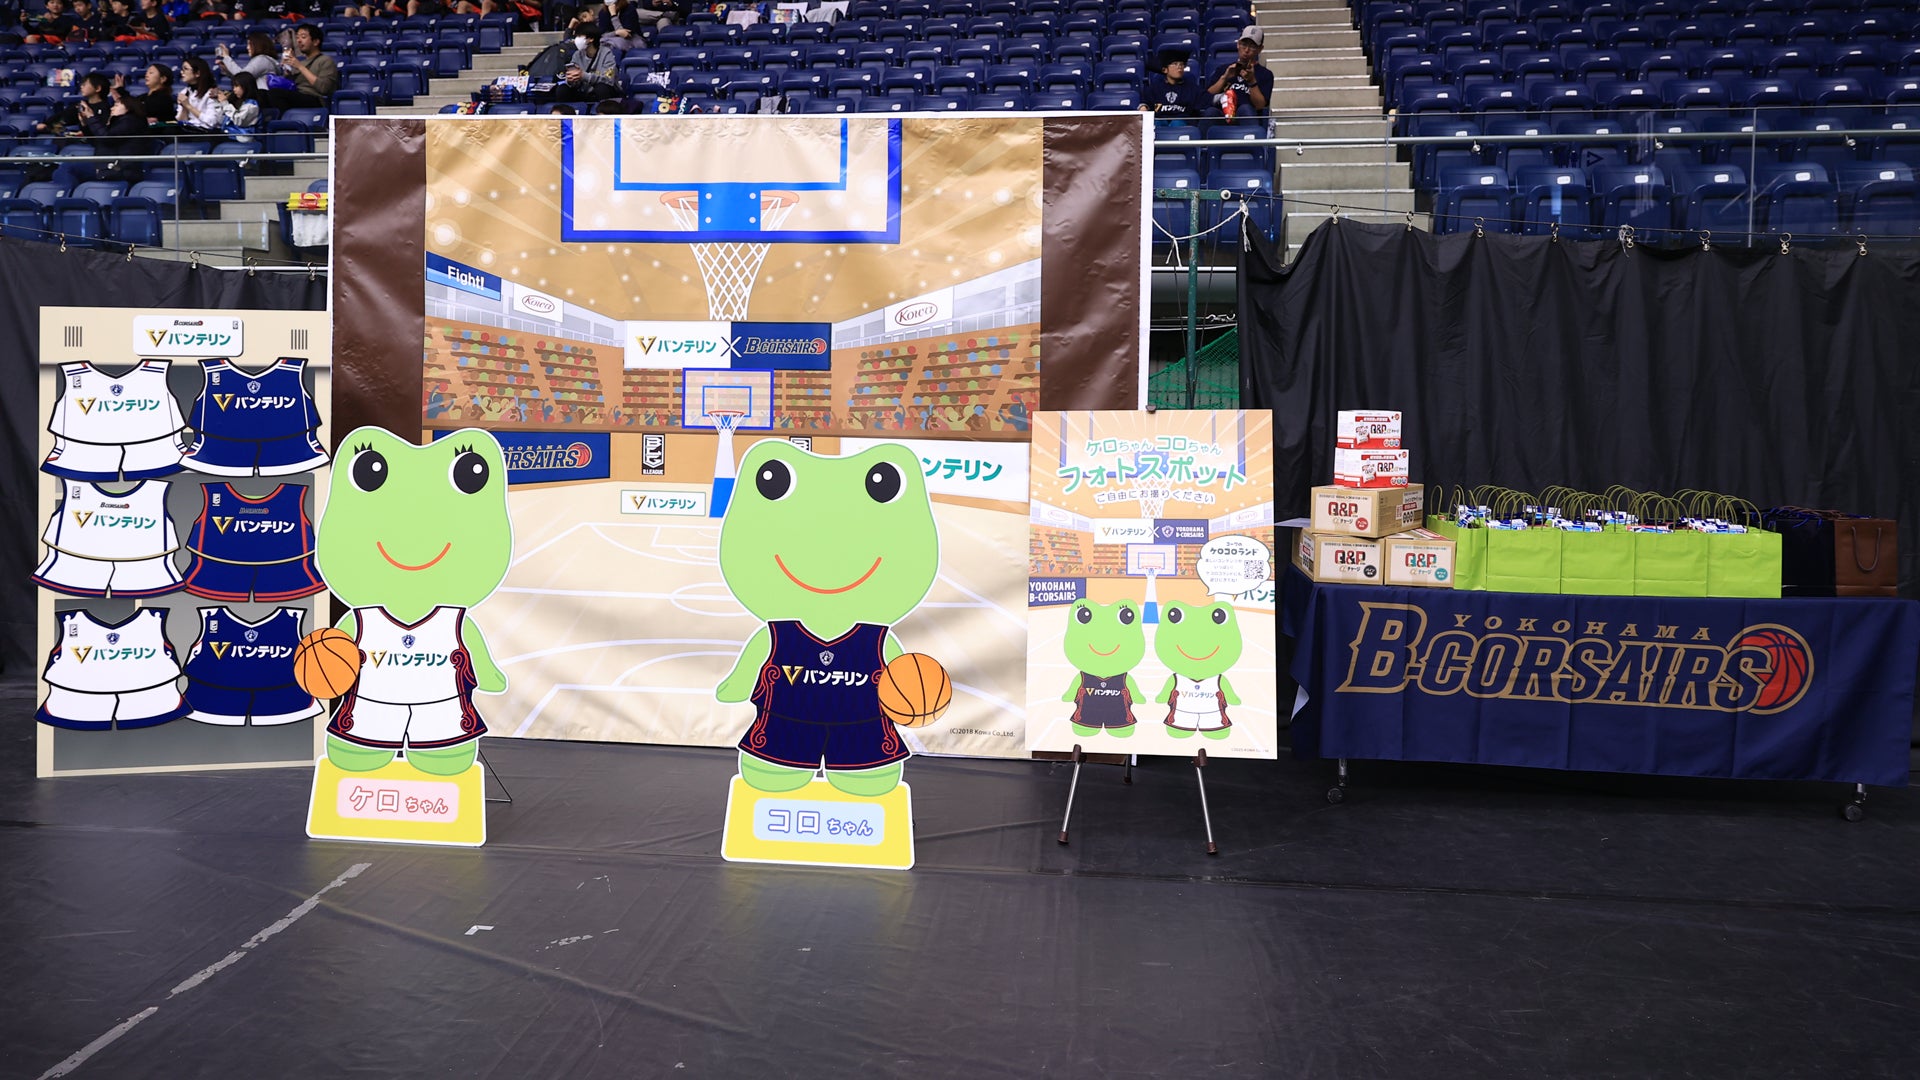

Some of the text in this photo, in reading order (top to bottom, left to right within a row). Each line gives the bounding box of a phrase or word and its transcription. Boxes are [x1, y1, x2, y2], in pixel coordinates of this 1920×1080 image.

[447, 265, 485, 290] Fight!
[525, 295, 553, 311] Kowa
[900, 306, 934, 322] Kowa
[168, 332, 231, 346] バンテリン
[657, 340, 717, 353] バンテリン
[97, 399, 160, 412] バンテリン
[234, 396, 296, 409] バンテリン
[1086, 437, 1222, 457] ケロちゃん コロちゃん
[922, 457, 1003, 481] ンテリン
[1058, 456, 1245, 492] フォトスポット
[1097, 489, 1214, 503] ご自由にお撮りください
[647, 498, 697, 510] バンテリン
[93, 515, 156, 530] バンテリン
[233, 520, 295, 534] バンテリン
[1112, 527, 1146, 536] バンテリン
[1210, 547, 1259, 556] ケロコロランド
[1029, 582, 1076, 591] YOKOHAMA
[1029, 592, 1076, 602] B-CORSAIRS
[1453, 613, 1711, 641] YOKOHAMA
[93, 647, 156, 661] バンテリン
[231, 645, 293, 658] バンテリン
[387, 653, 448, 667] バンテリン
[803, 670, 868, 687] バンテリン
[349, 786, 449, 815] ケロちゃん
[768, 809, 874, 836] コロちゃん
